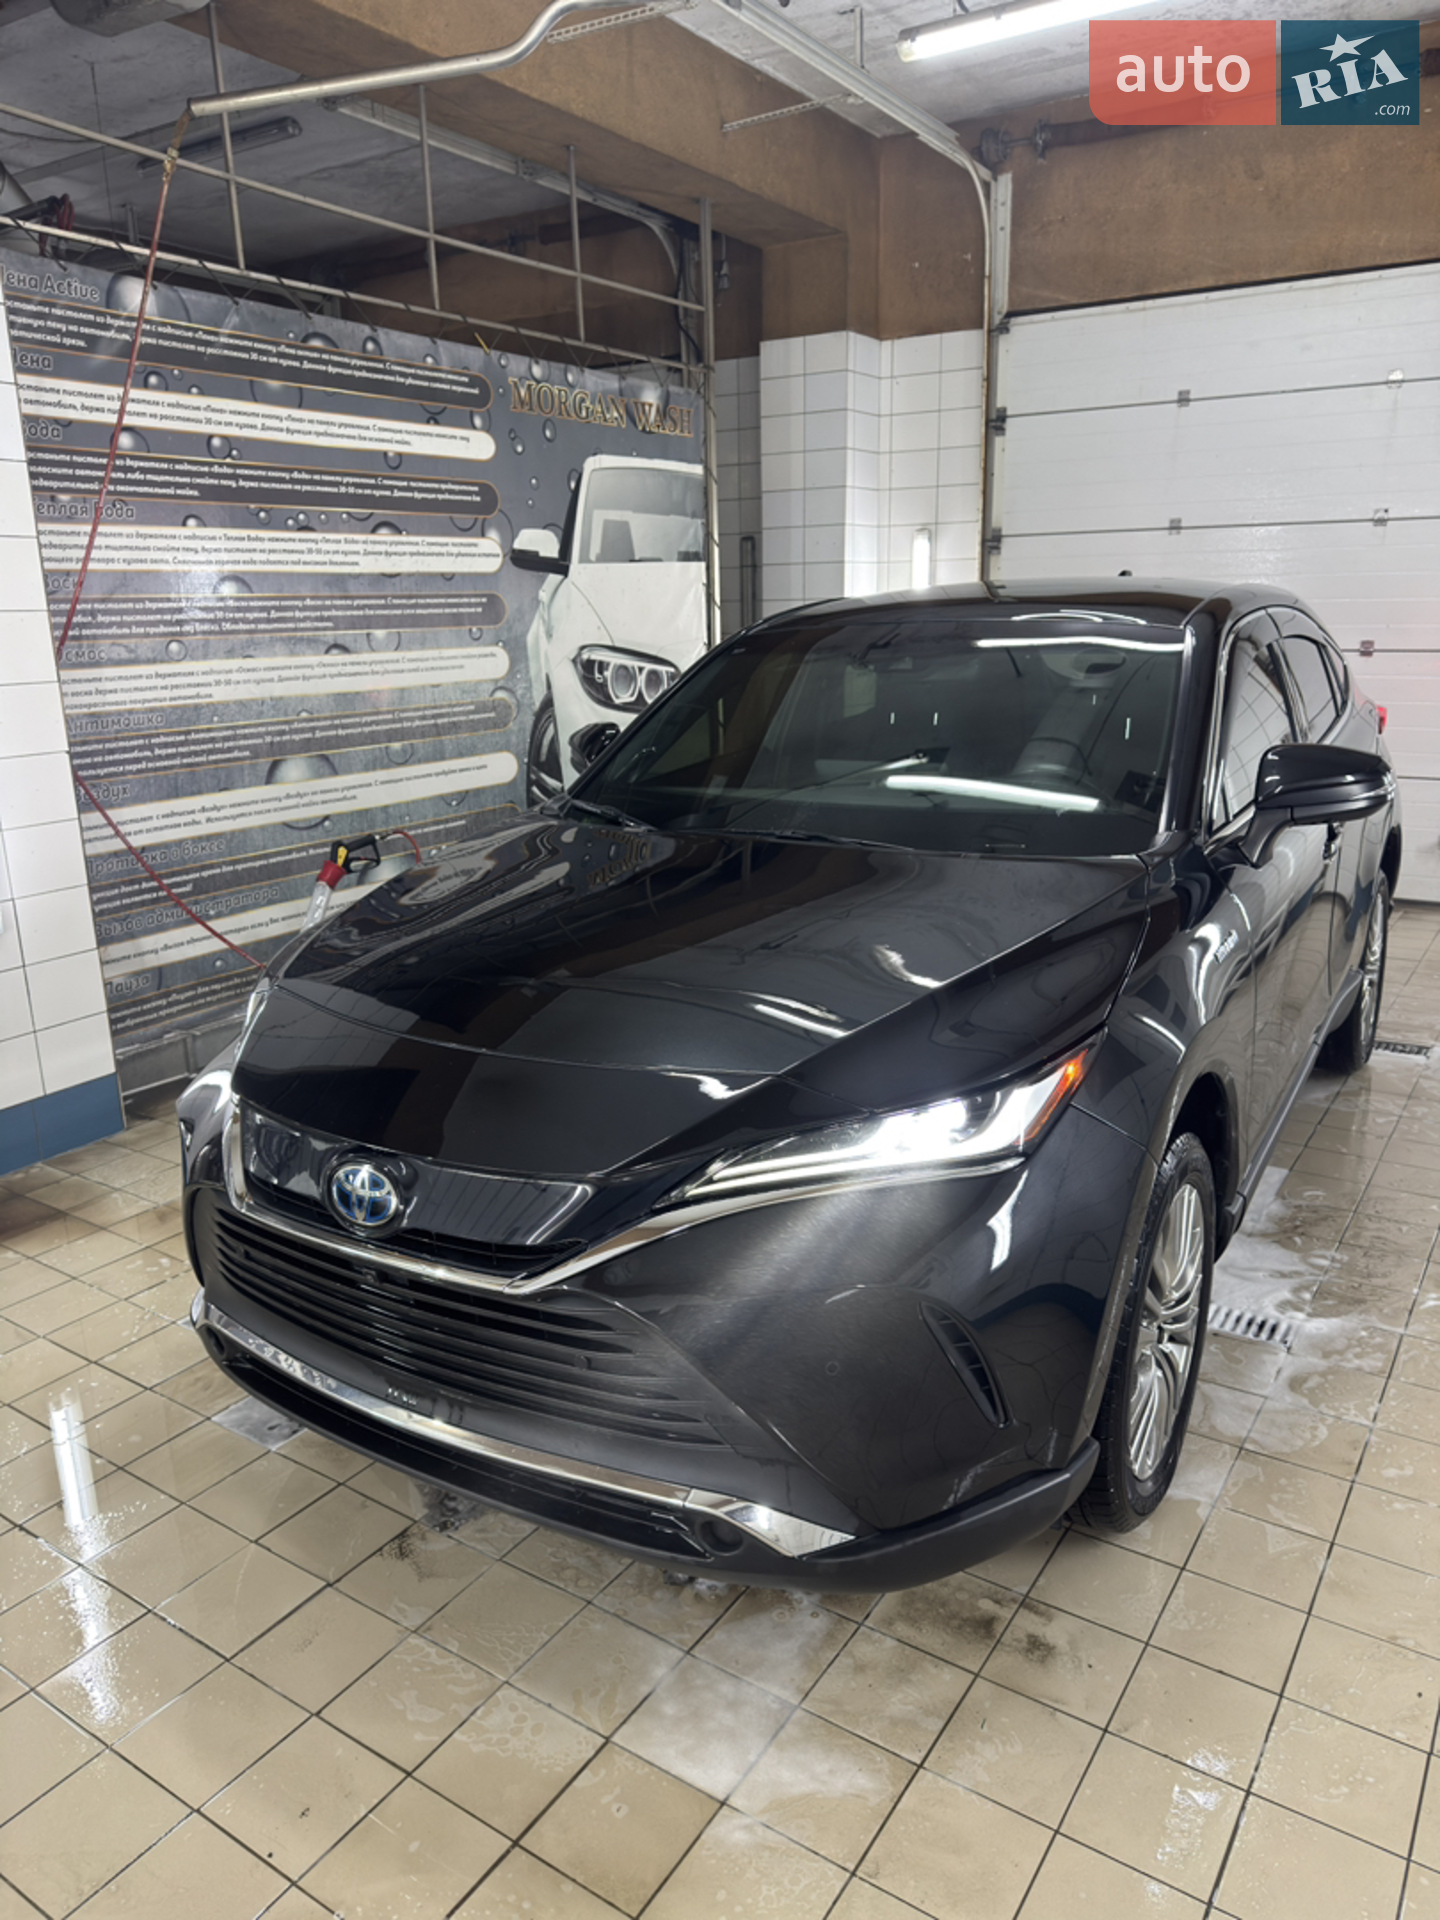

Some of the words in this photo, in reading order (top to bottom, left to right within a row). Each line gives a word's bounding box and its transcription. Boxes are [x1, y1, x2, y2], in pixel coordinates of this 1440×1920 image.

[44, 274, 100, 300] Active
[508, 376, 627, 429] MORGAN
[632, 398, 694, 437] WASH
[22, 418, 62, 441] ода
[33, 496, 89, 518] еплая
[182, 839, 226, 857] боксе
[146, 886, 279, 926] администратора
